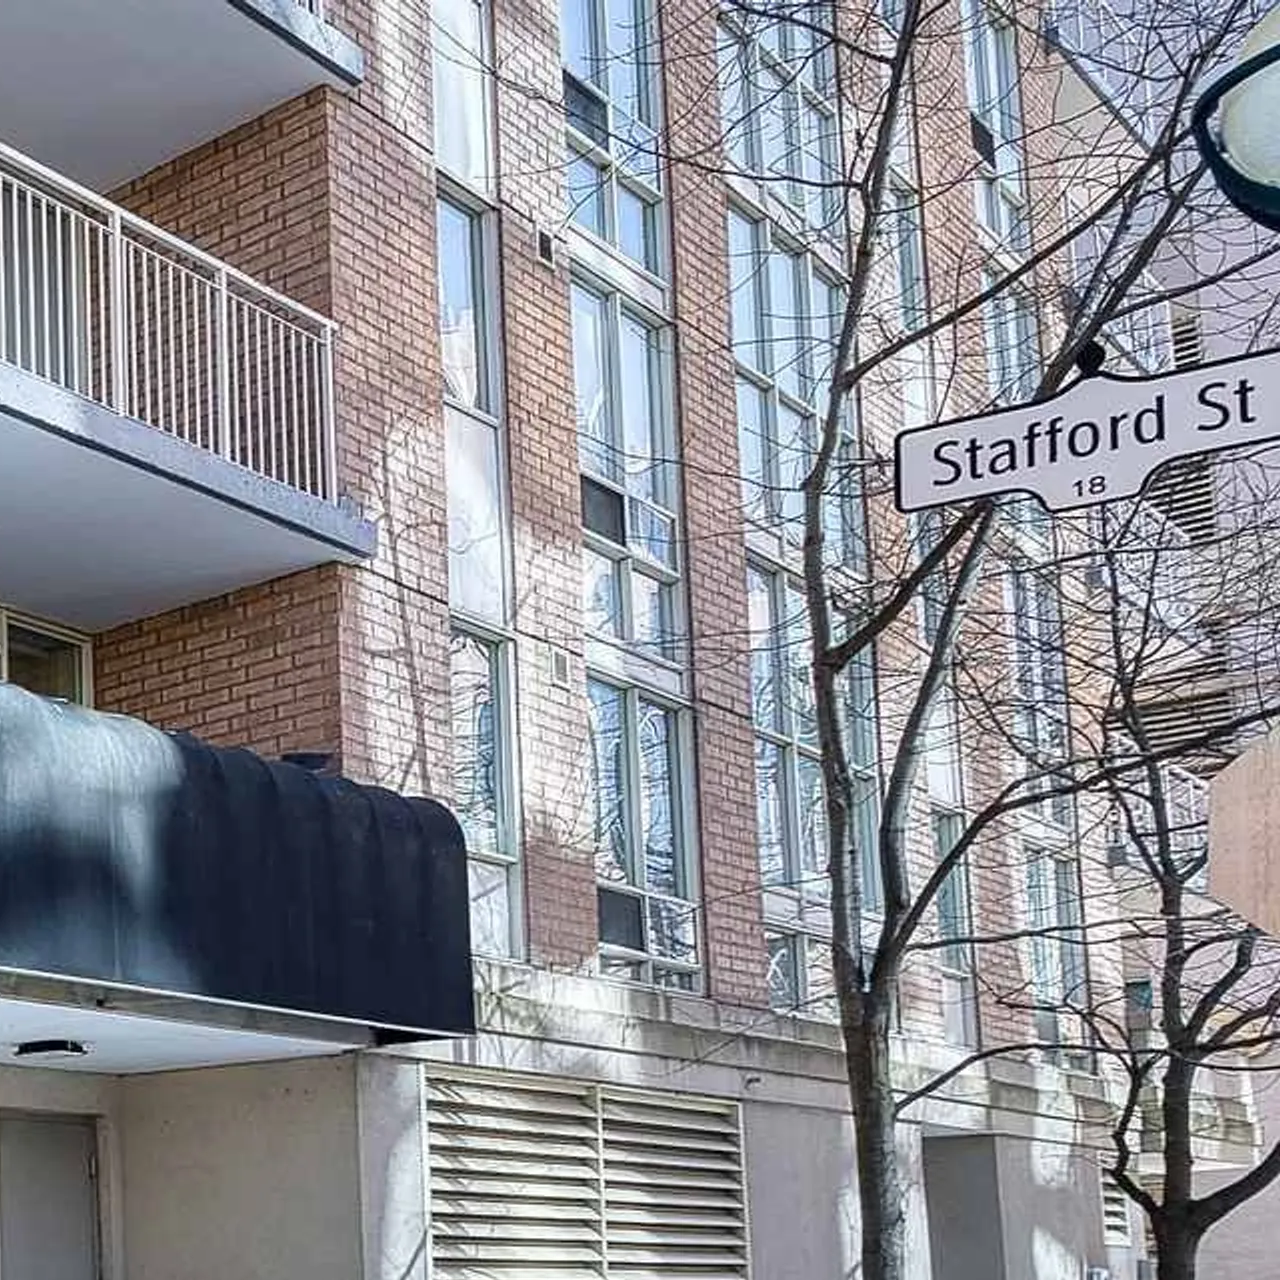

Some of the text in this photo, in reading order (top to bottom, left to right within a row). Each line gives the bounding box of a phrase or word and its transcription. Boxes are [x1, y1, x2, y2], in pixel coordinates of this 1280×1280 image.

[932, 378, 1257, 487] Stafford St
[1071, 475, 1107, 497] 18
